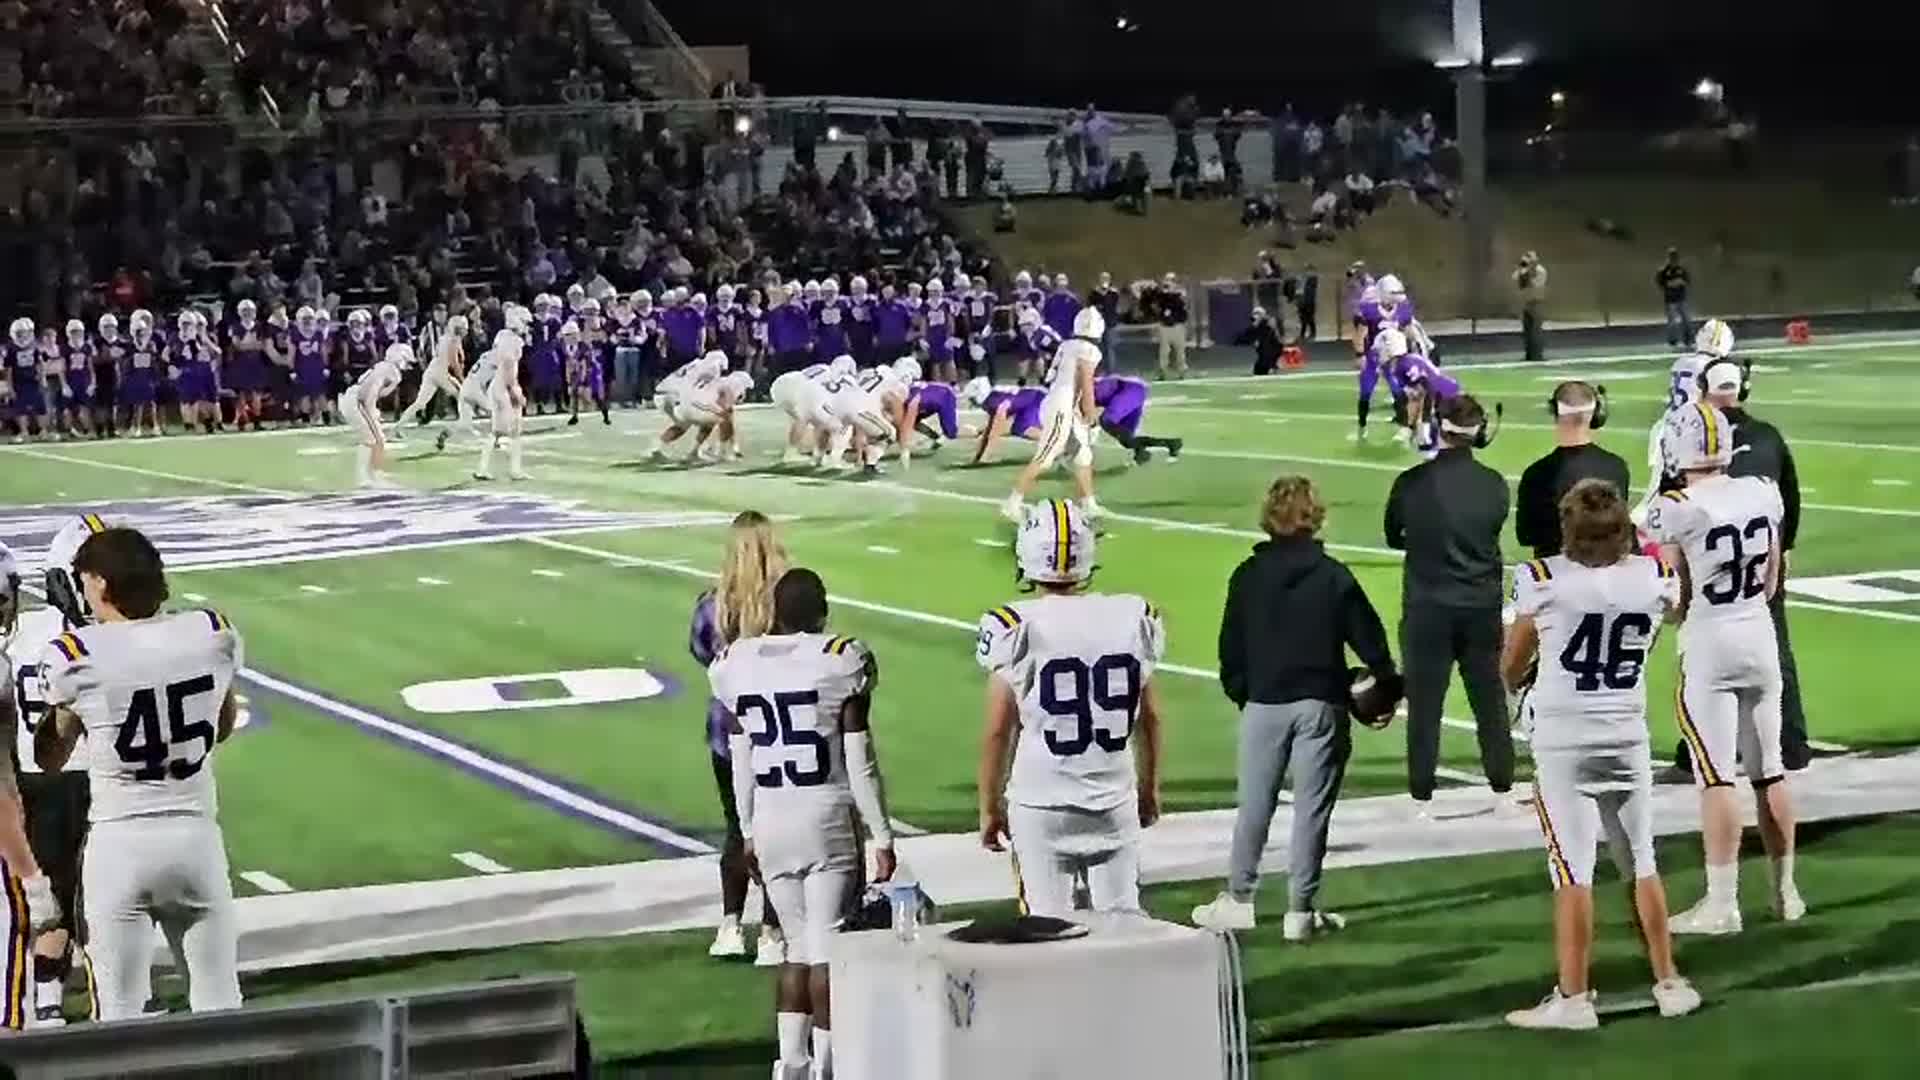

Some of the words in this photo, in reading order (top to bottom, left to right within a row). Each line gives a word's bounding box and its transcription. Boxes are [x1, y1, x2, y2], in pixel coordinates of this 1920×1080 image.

[1650, 508, 1662, 529] 2
[1702, 516, 1772, 605] 32
[1559, 613, 1652, 691] 46
[115, 674, 214, 780] 45
[736, 690, 831, 787] 25
[1040, 653, 1141, 756] 99
